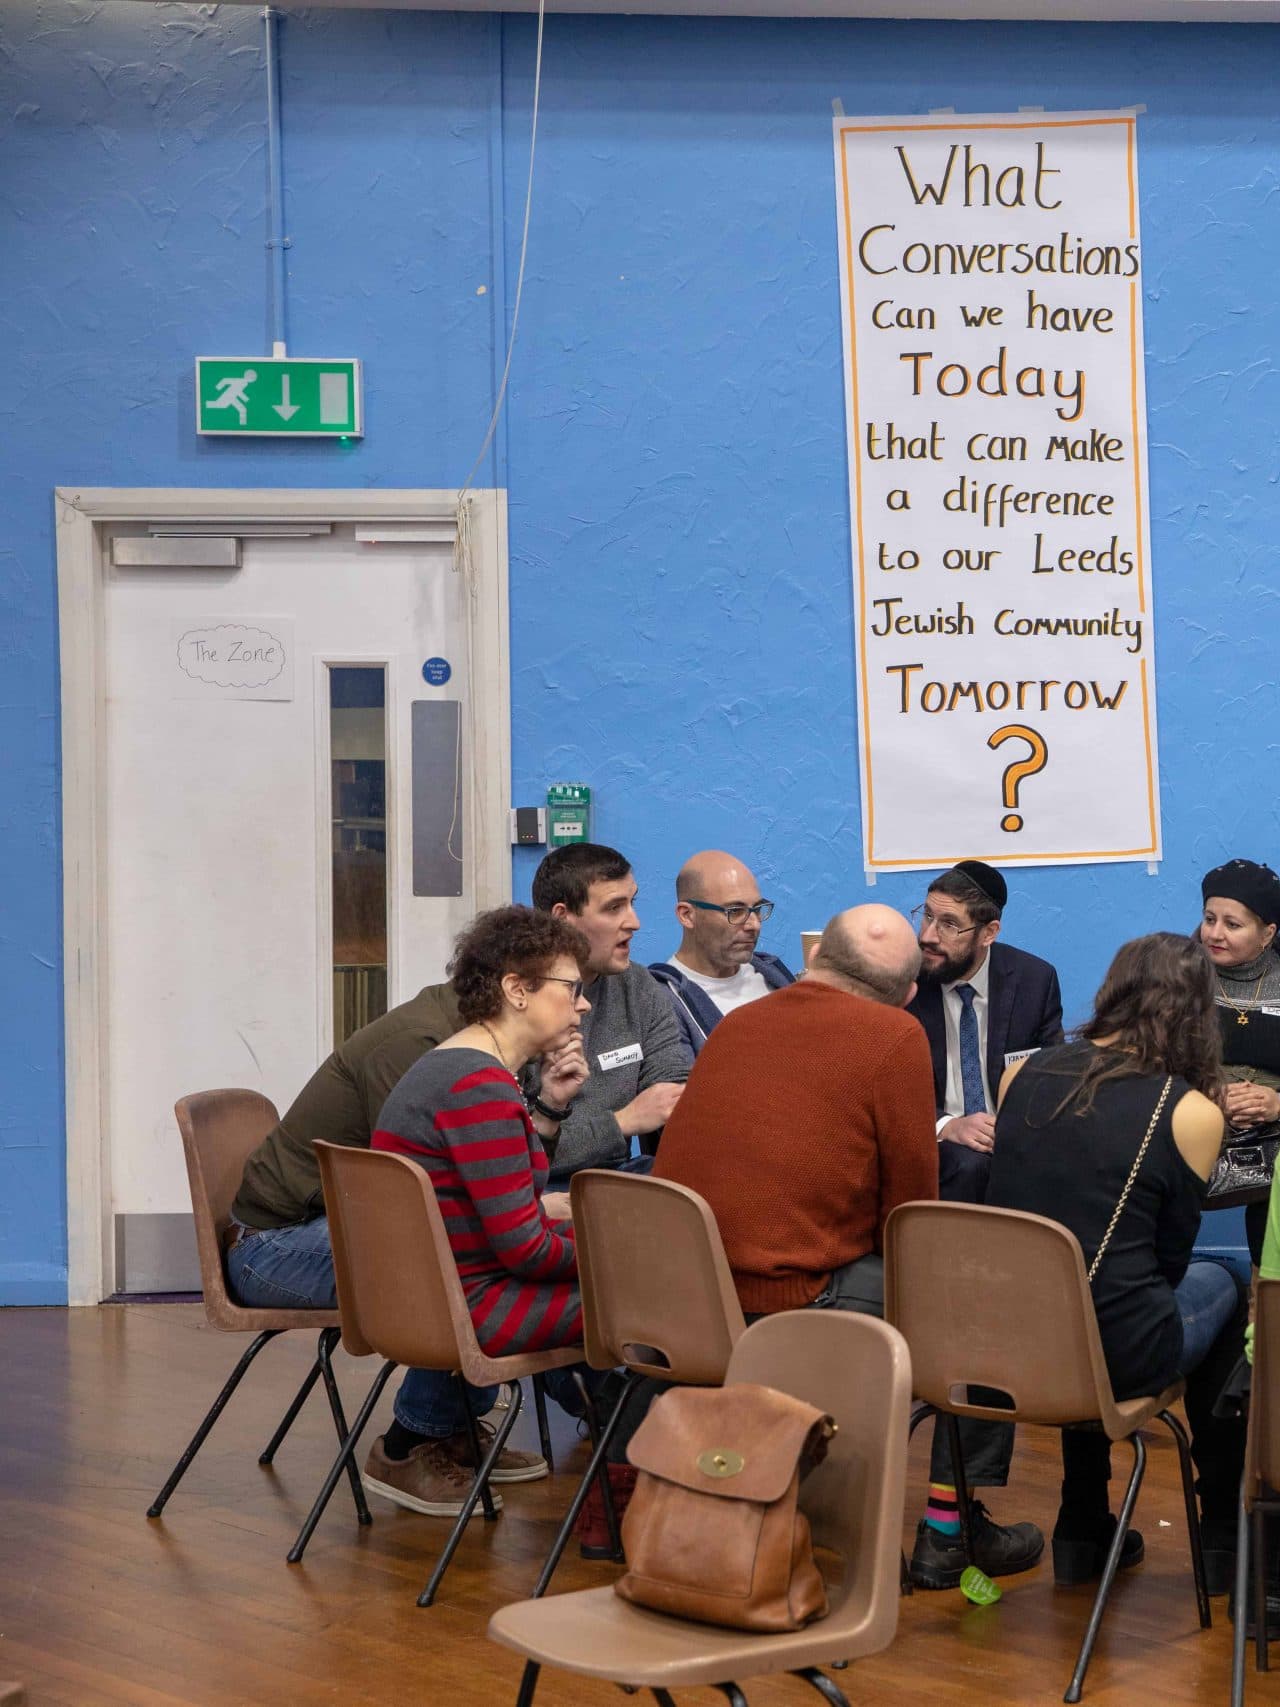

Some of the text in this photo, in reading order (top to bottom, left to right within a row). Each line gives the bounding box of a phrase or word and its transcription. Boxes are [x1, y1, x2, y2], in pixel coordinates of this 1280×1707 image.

[894, 142, 1062, 209] What
[859, 224, 1139, 277] Conversations
[960, 305, 1003, 327] we
[1026, 289, 1114, 332] have
[900, 346, 1085, 422] Today
[866, 421, 945, 461] that
[887, 476, 1115, 527] a difference
[878, 533, 1134, 575] to our Leeds
[190, 640, 275, 662] The Zone
[871, 598, 1143, 654] Jewish Community
[987, 724, 1048, 832] ?
